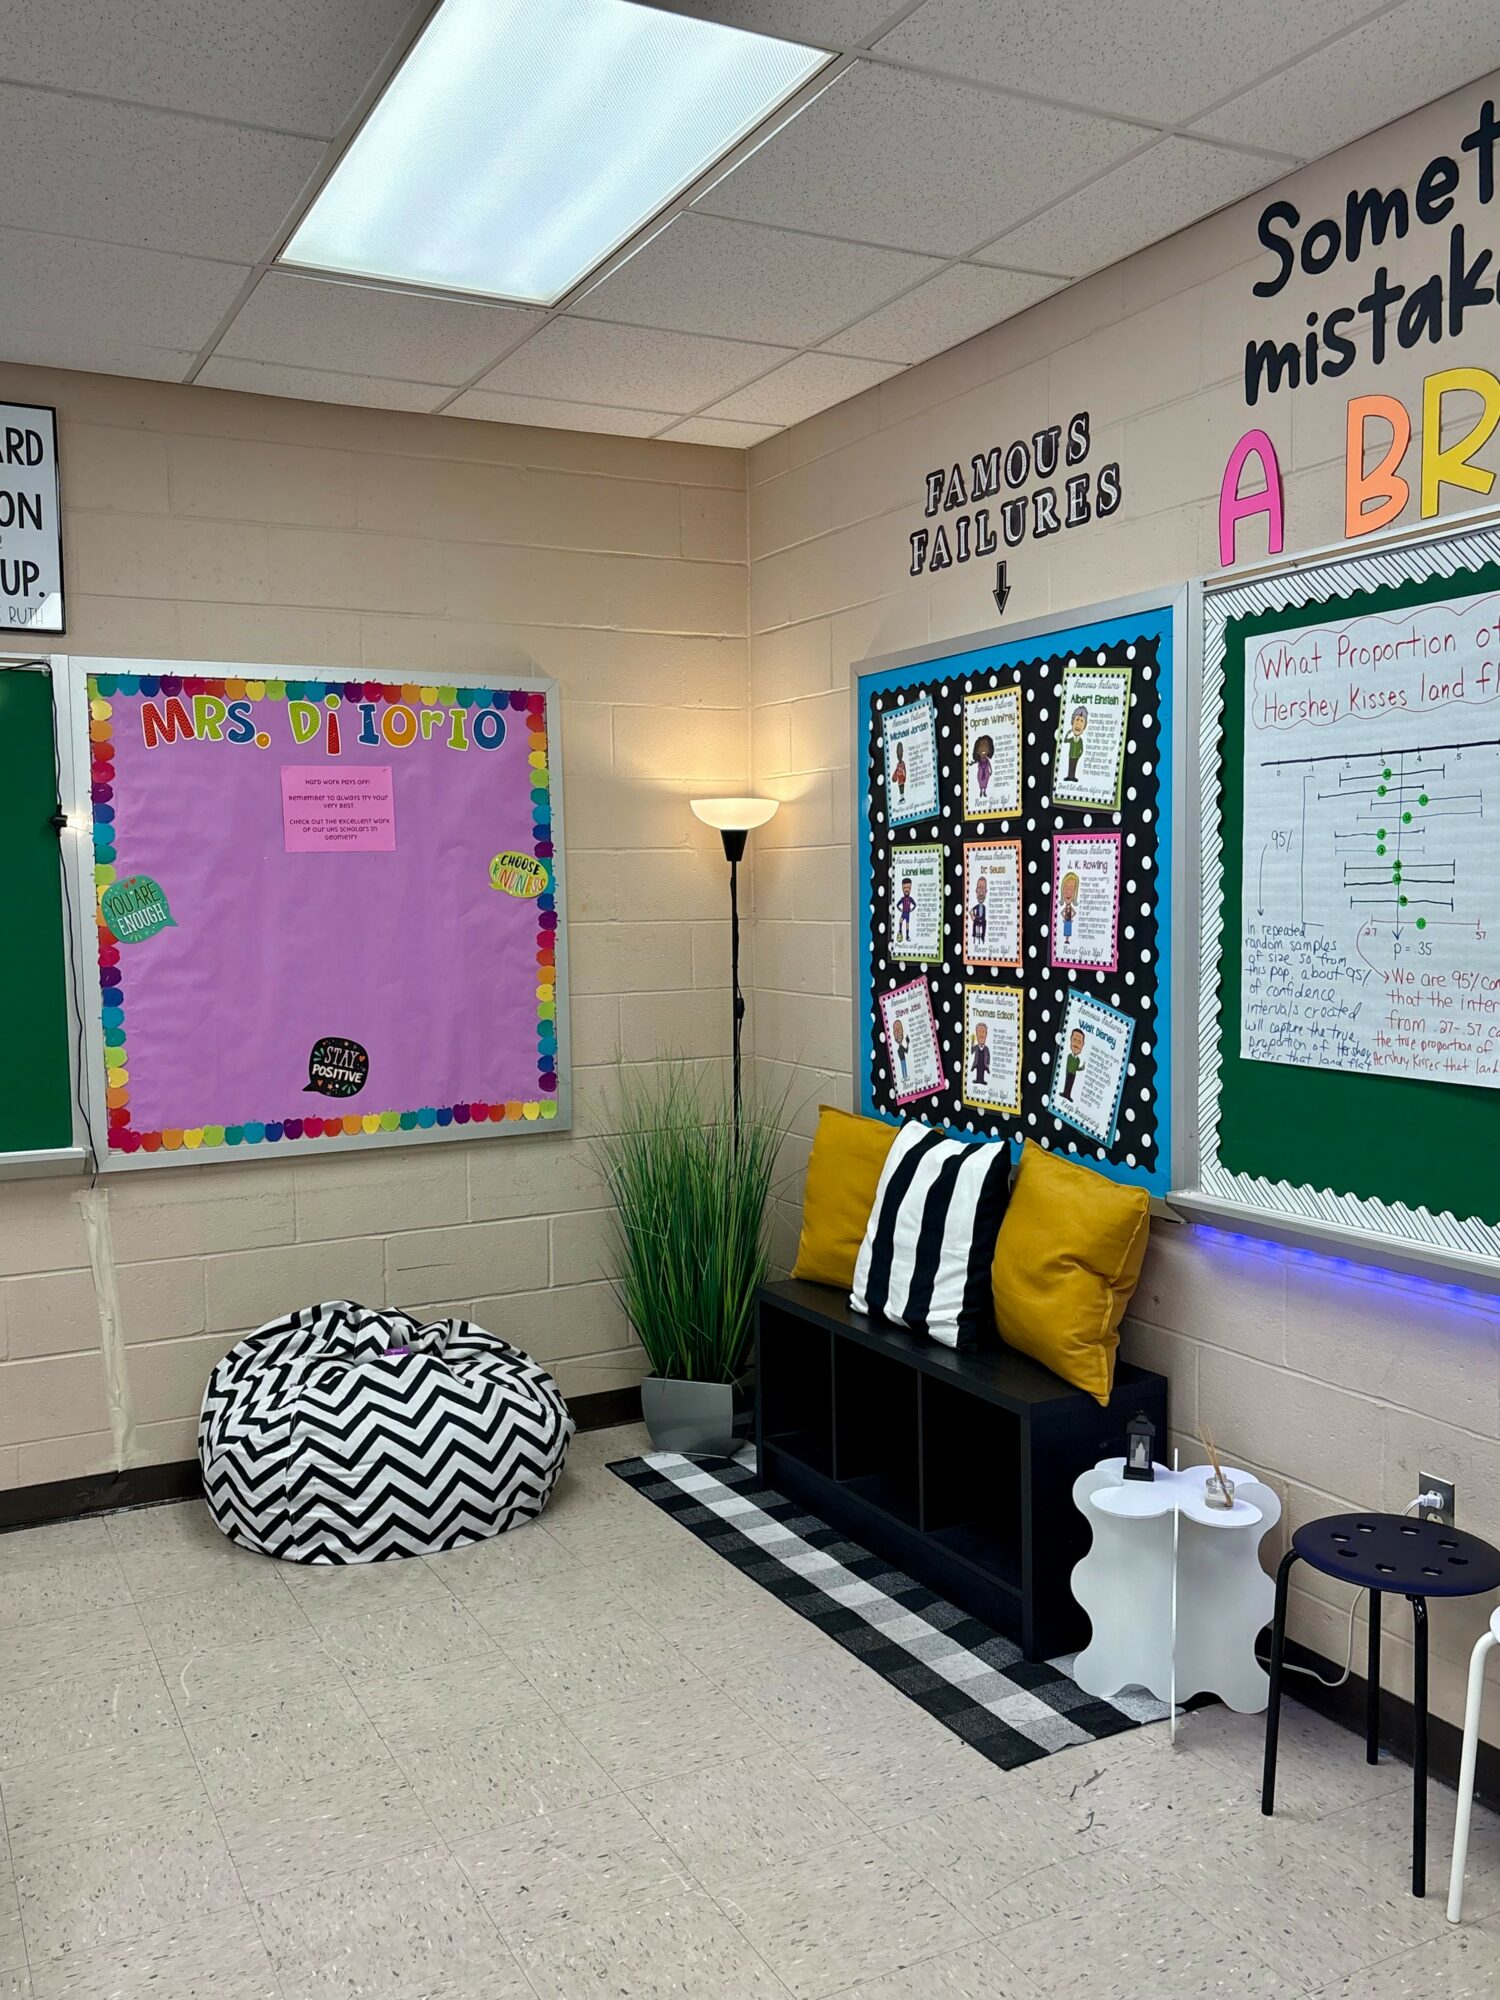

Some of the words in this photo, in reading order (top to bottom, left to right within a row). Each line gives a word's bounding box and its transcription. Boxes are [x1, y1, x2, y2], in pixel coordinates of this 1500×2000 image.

[1245, 224, 1500, 406] mistak
[0, 427, 43, 466] RD
[925, 412, 1089, 517] FAMOUS
[1219, 429, 1283, 567] A
[910, 462, 1122, 576] FAILURES
[1260, 641, 1322, 680] What
[1337, 626, 1456, 671] Proportion
[1070, 694, 1093, 705] Albert
[1094, 694, 1119, 705] Einstein
[1264, 688, 1339, 722] Hershey
[1350, 683, 1408, 712] Kisses
[1421, 667, 1465, 702] land
[141, 695, 271, 749] MRS.
[970, 718, 990, 731] Oprah
[991, 712, 1016, 725] Winfrey
[1378, 759, 1386, 767] .3
[500, 855, 541, 875] CHOOSE
[989, 865, 1006, 874] Seuss
[1082, 860, 1109, 874] Rowling
[492, 863, 546, 896] KINDNESS
[105, 893, 134, 918] YOU
[134, 881, 161, 908] ARE
[117, 903, 167, 936] ENOUGH
[1247, 917, 1256, 936] In
[1262, 923, 1306, 940] repeated
[1245, 935, 1283, 950] random
[1290, 935, 1337, 955] samples
[1248, 949, 1264, 964] of
[1268, 953, 1293, 966] size
[1316, 952, 1347, 967] from
[1244, 965, 1266, 976] this
[1301, 964, 1345, 981] about
[1391, 967, 1415, 985] We
[1420, 973, 1448, 988] are
[1249, 977, 1262, 995] of
[1266, 980, 1335, 1003] confidence
[1385, 988, 1424, 1007] that
[1426, 991, 1453, 1008] the
[895, 1007, 909, 1018] Steve
[909, 1002, 921, 1013] Jobs
[972, 1007, 996, 1019] Thomas
[996, 1009, 1015, 1021] Edison
[1247, 1000, 1299, 1018] intervals
[1304, 998, 1362, 1022] created
[1385, 1009, 1426, 1033] from
[1078, 1019, 1095, 1035] Walt
[1095, 1027, 1117, 1051] Disney
[1244, 1018, 1264, 1032] will
[1307, 1021, 1325, 1038] the
[1312, 1039, 1330, 1052] of
[1372, 1030, 1393, 1048] the
[1395, 1033, 1416, 1051] true
[1421, 1038, 1472, 1054] proportion
[1476, 1039, 1494, 1054] of
[324, 1045, 360, 1069] STAY
[1286, 1050, 1312, 1063] that
[1319, 1053, 1343, 1067] land
[1442, 1057, 1469, 1071] that
[312, 1063, 364, 1083] POSITIVE
